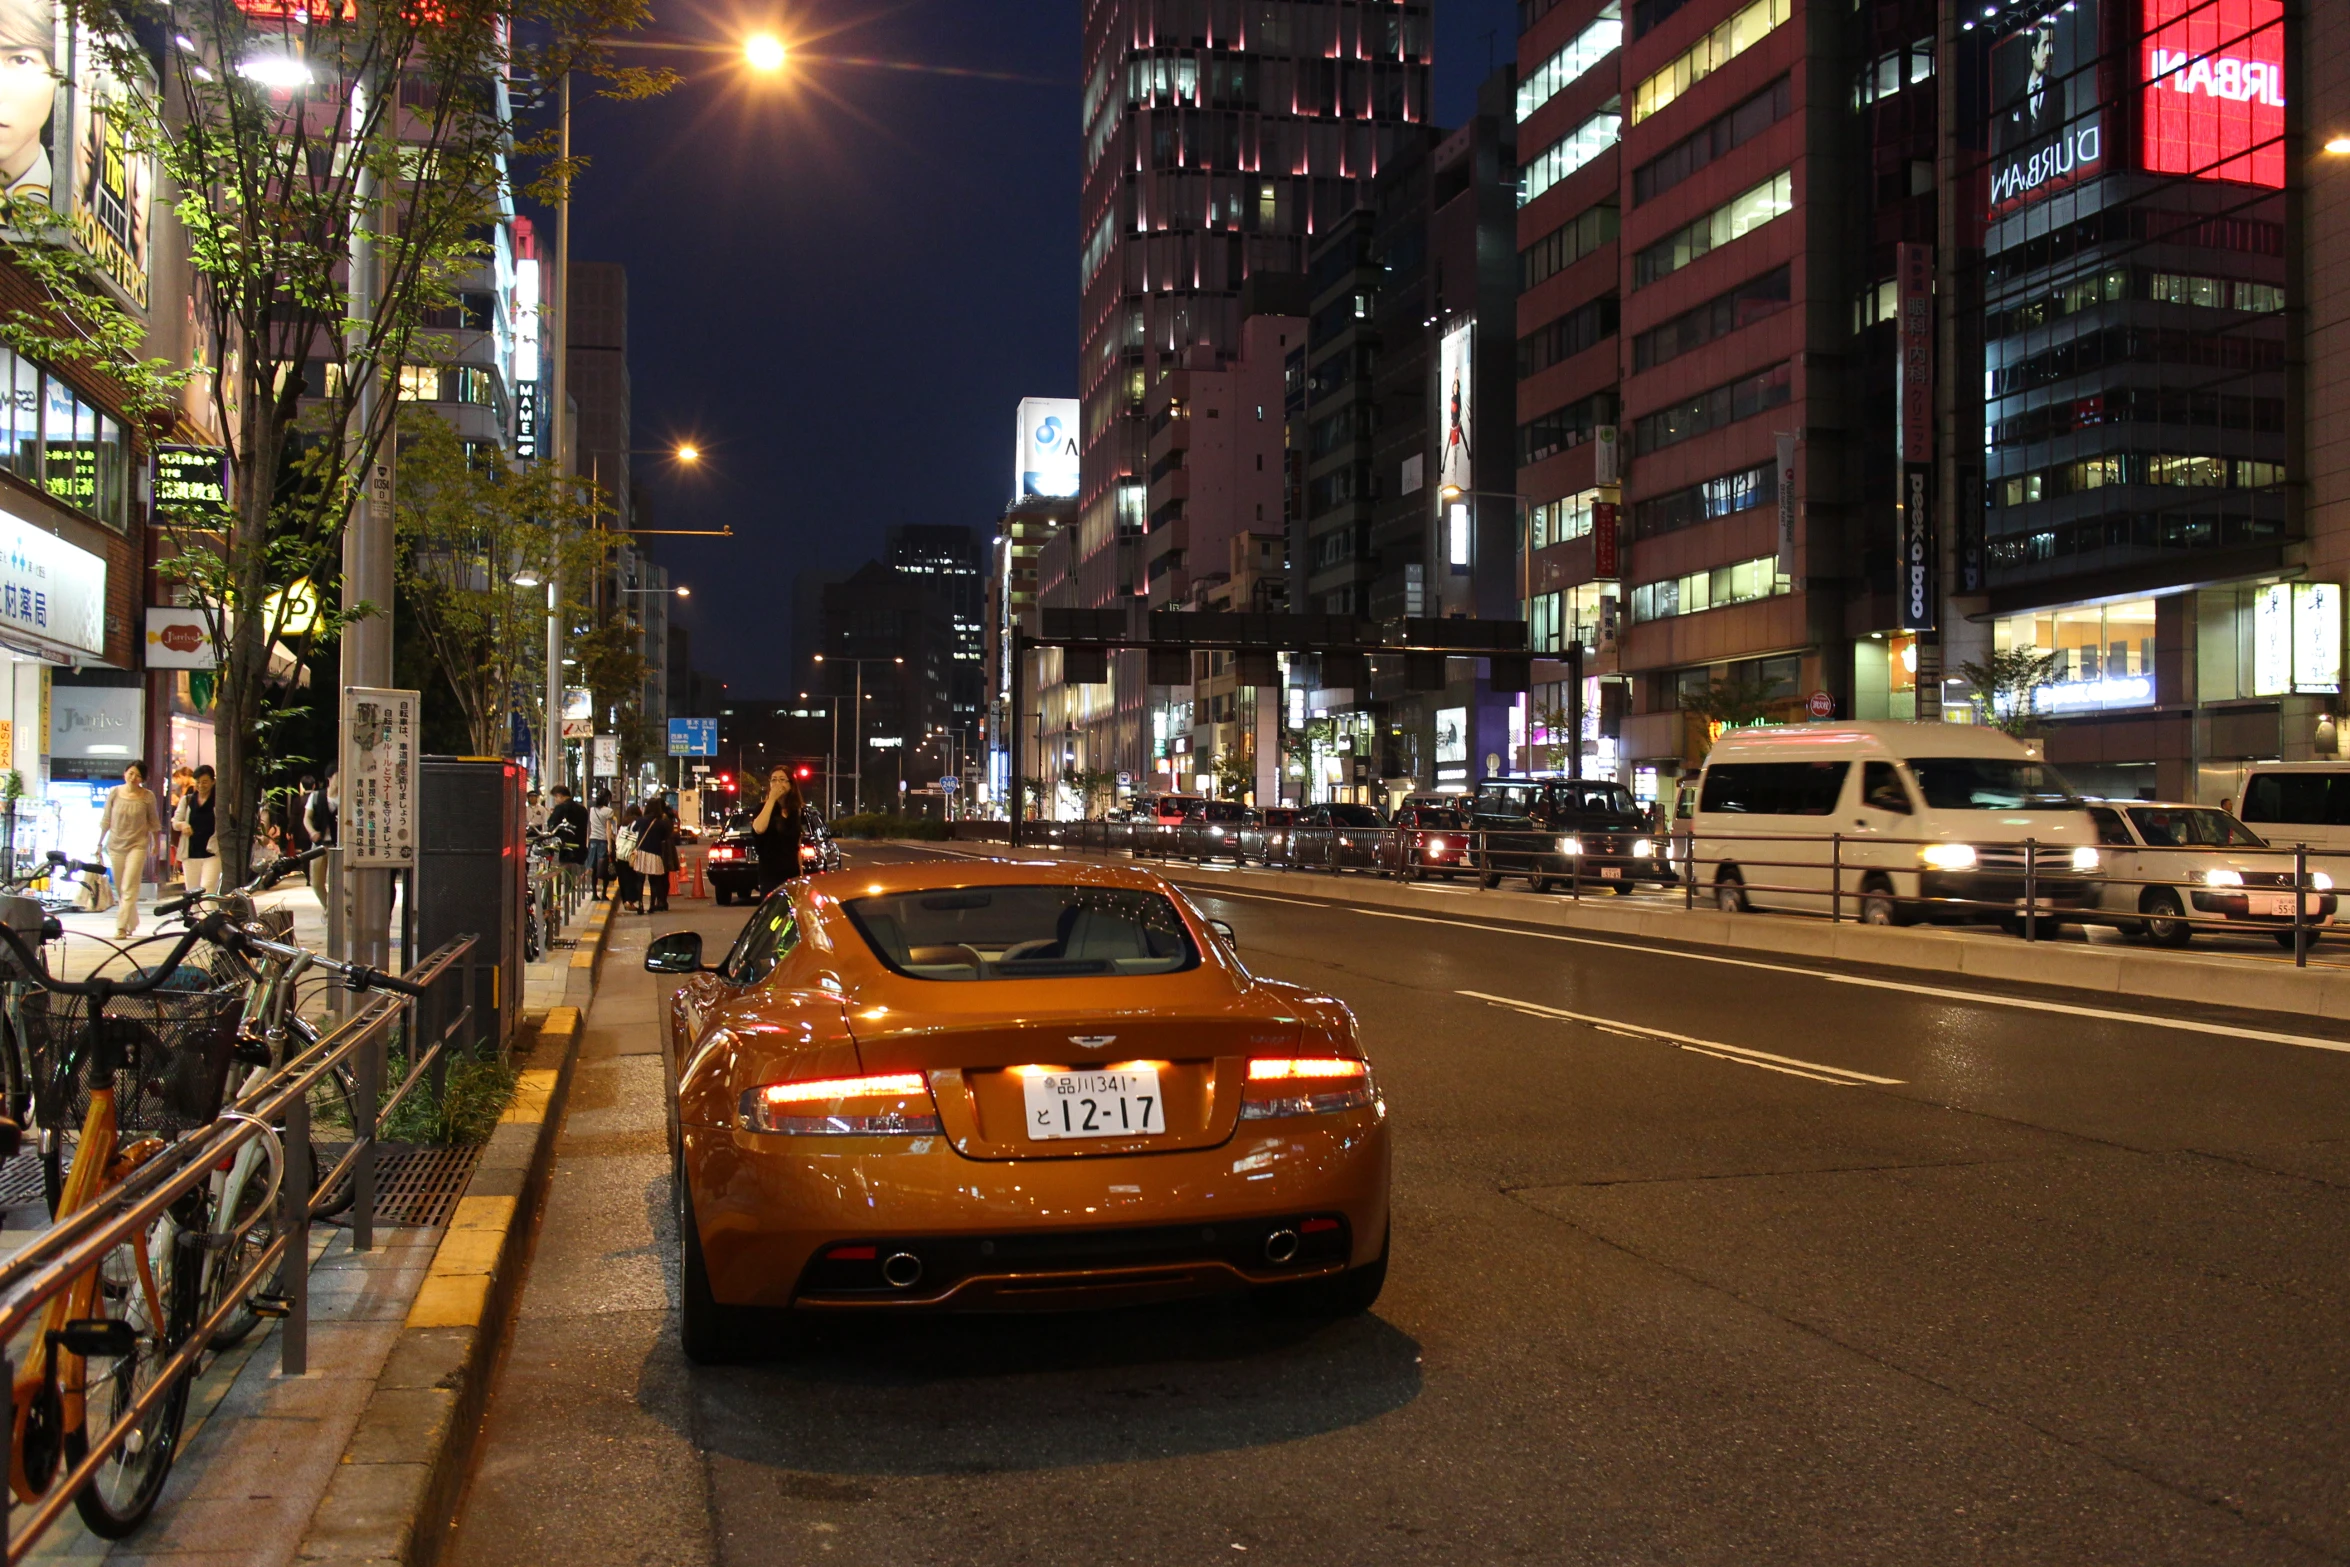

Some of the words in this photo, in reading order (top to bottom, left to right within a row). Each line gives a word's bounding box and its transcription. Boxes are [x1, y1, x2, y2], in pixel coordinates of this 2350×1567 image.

[104, 147, 125, 201] TBS
[72, 194, 148, 310] MONSTERS
[520, 384, 533, 434] MAME
[0, 580, 46, 628] 村薬局
[287, 598, 308, 625] P
[575, 724, 591, 733] 入口
[1037, 1109, 1051, 1126] と
[1062, 1096, 1154, 1132] 12-17
